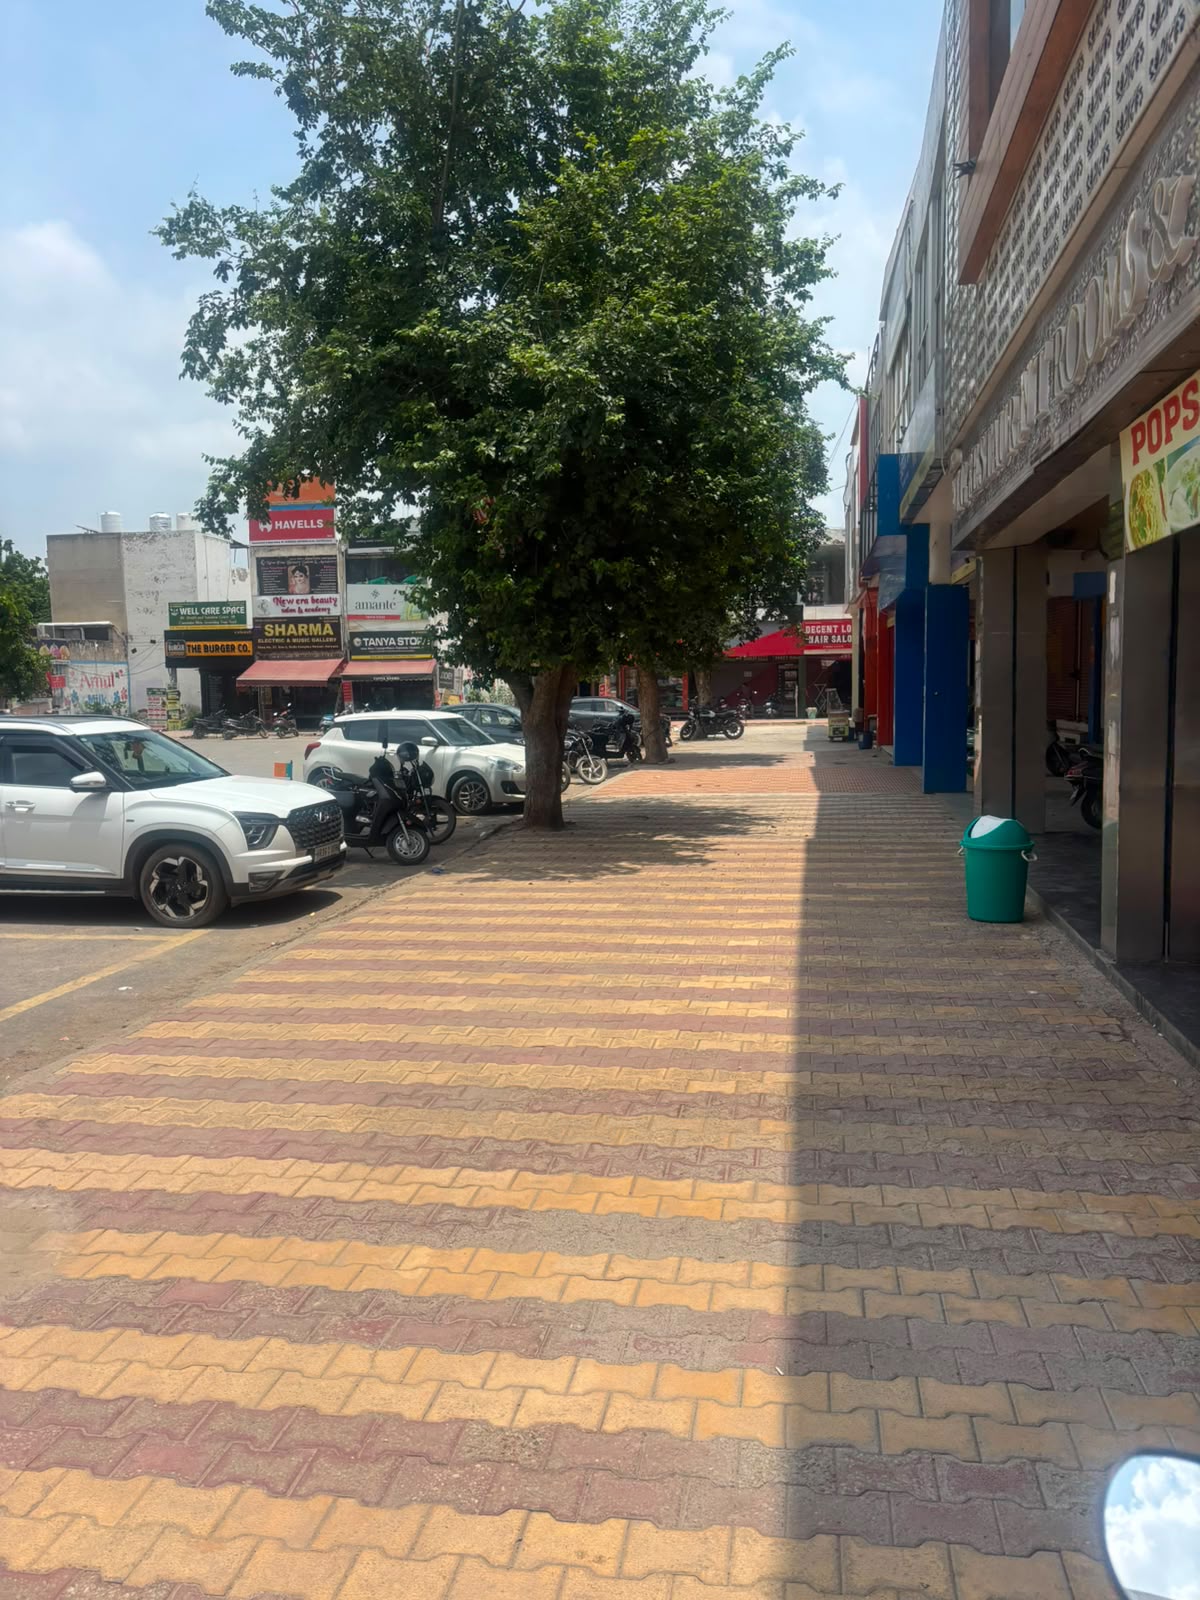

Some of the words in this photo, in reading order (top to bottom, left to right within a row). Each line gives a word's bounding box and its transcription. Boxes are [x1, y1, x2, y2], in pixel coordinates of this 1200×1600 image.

[1052, 208, 1150, 400] ROOMS
[1147, 175, 1198, 283] &
[1131, 378, 1200, 466] POPS
[274, 519, 324, 530] HAVELLS
[273, 597, 294, 607] New
[311, 596, 338, 607] beauty
[355, 597, 396, 610] amanté
[179, 607, 199, 616] WELL
[201, 607, 220, 615] CARE
[222, 606, 245, 615] SPACE
[264, 623, 334, 637] SHARMA
[805, 625, 838, 634] DECENT
[362, 637, 395, 647] TANYA
[187, 644, 202, 653] THE
[203, 643, 236, 653] BURGER
[237, 643, 251, 653] CO.
